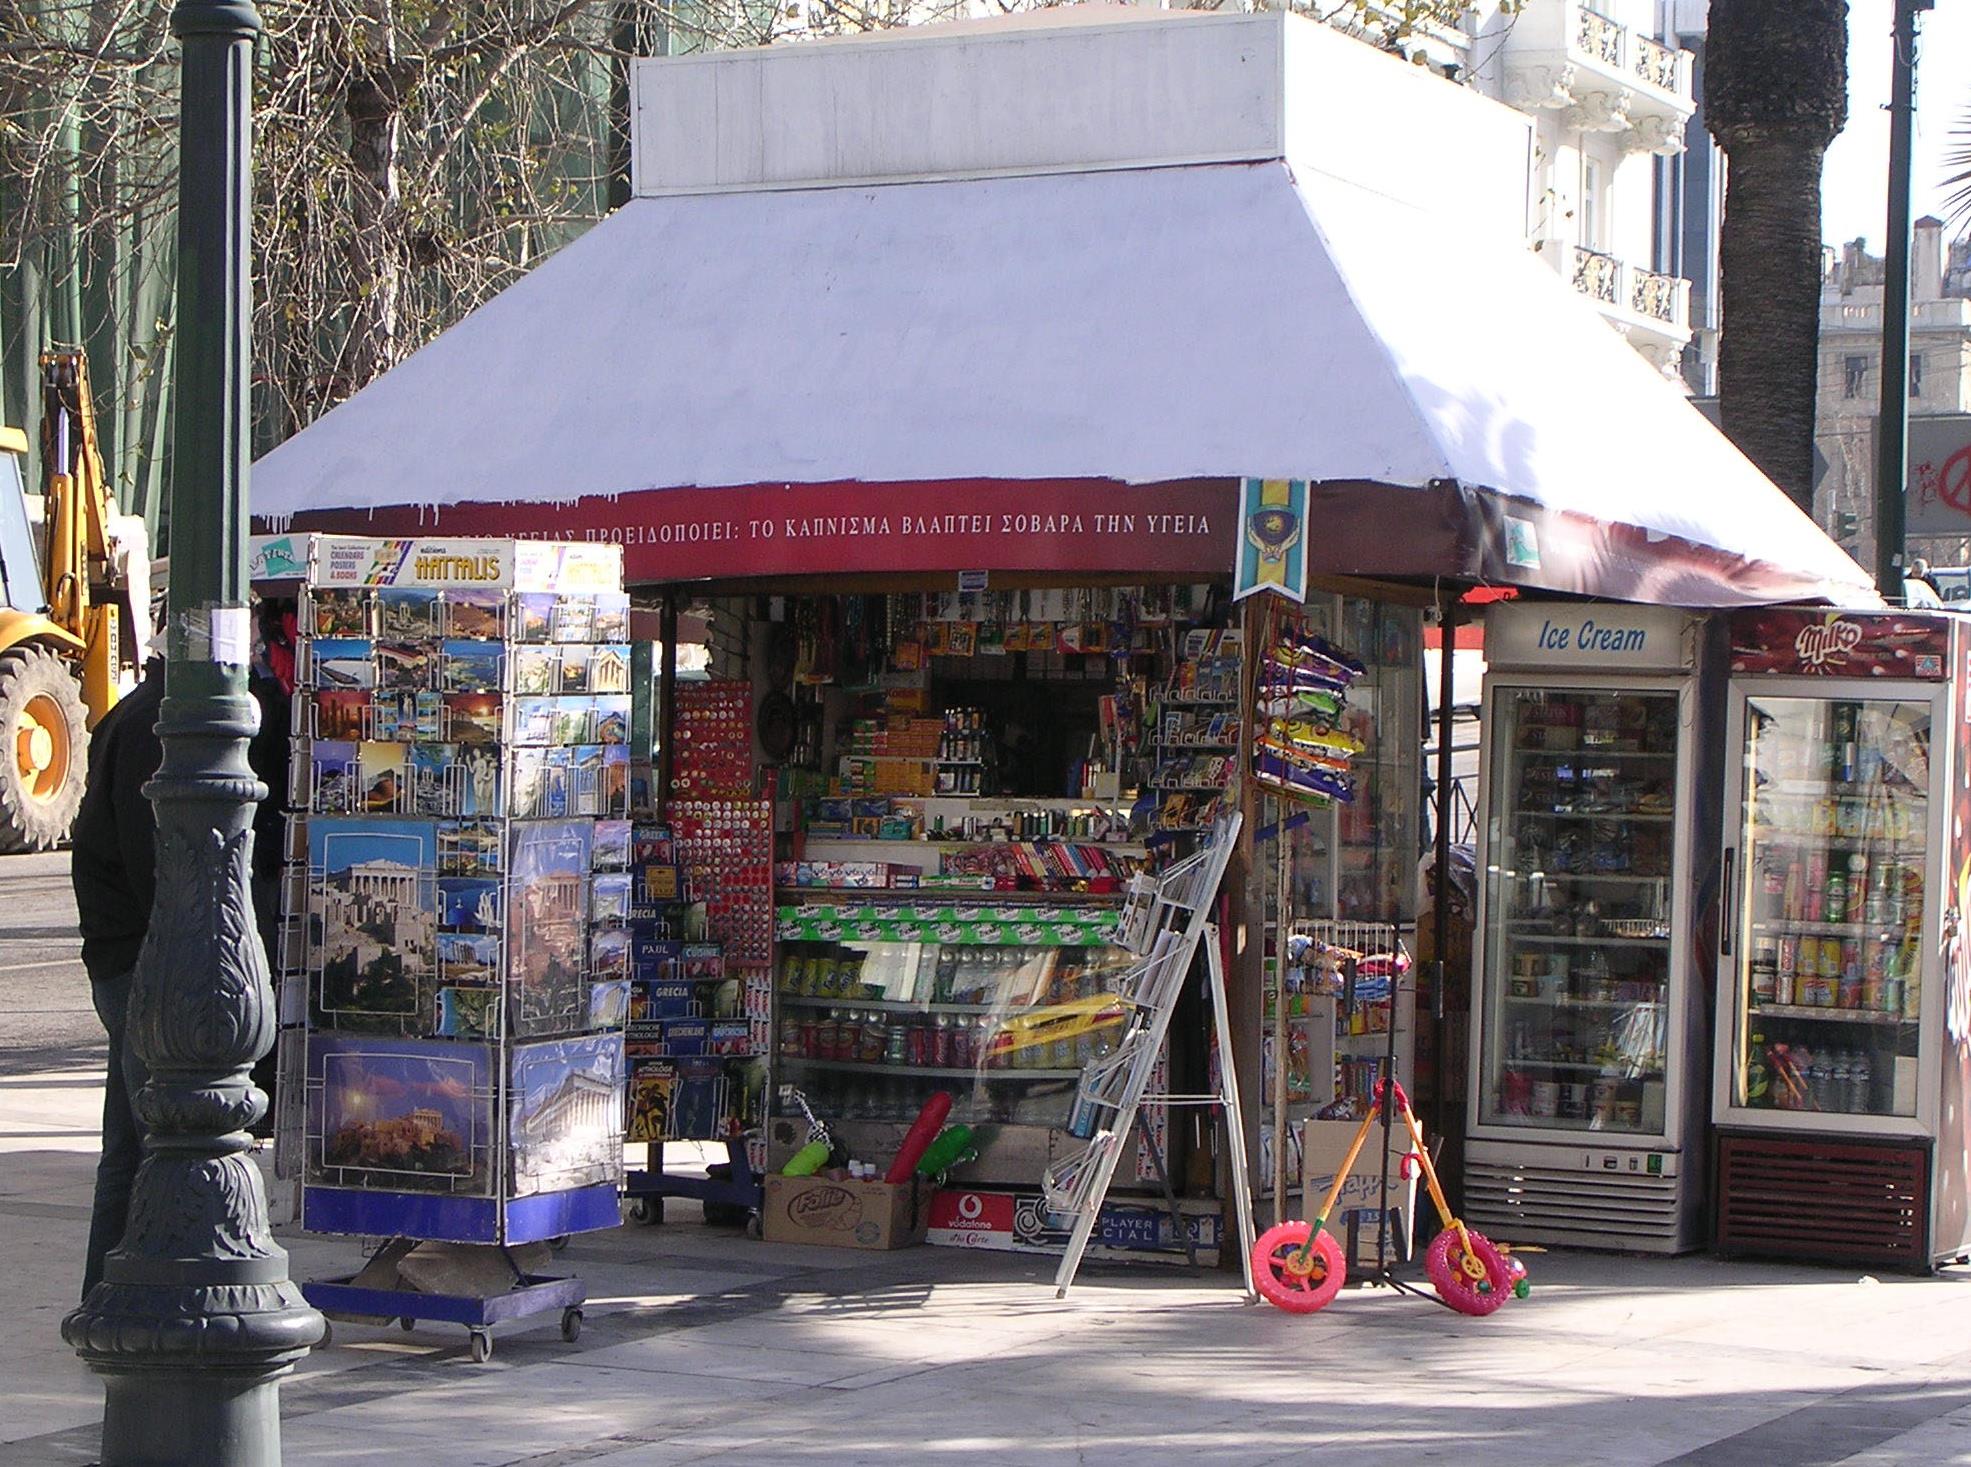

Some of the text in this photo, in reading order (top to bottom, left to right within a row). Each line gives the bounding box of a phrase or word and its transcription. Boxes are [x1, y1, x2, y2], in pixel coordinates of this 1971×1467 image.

[749, 519, 774, 538] ΤΟ
[785, 516, 891, 538] ΚΑΠΝΙΣΜΑ
[902, 514, 992, 534] ΒΛΑΠΤΕΙ
[1001, 513, 1084, 533] ΣΟΒΑΡΑ
[1094, 514, 1135, 533] ΤΗΝ
[1147, 514, 1210, 534] ΥΓΕΙΑ
[330, 551, 364, 560] CALENDARS
[330, 560, 355, 570] POSTERS
[335, 571, 357, 580] BOOKS
[1537, 620, 1646, 651] Ice Cream
[655, 987, 689, 998] GRECIA
[948, 1218, 992, 1230] vodafone
[1101, 1216, 1153, 1230] PLAYER
